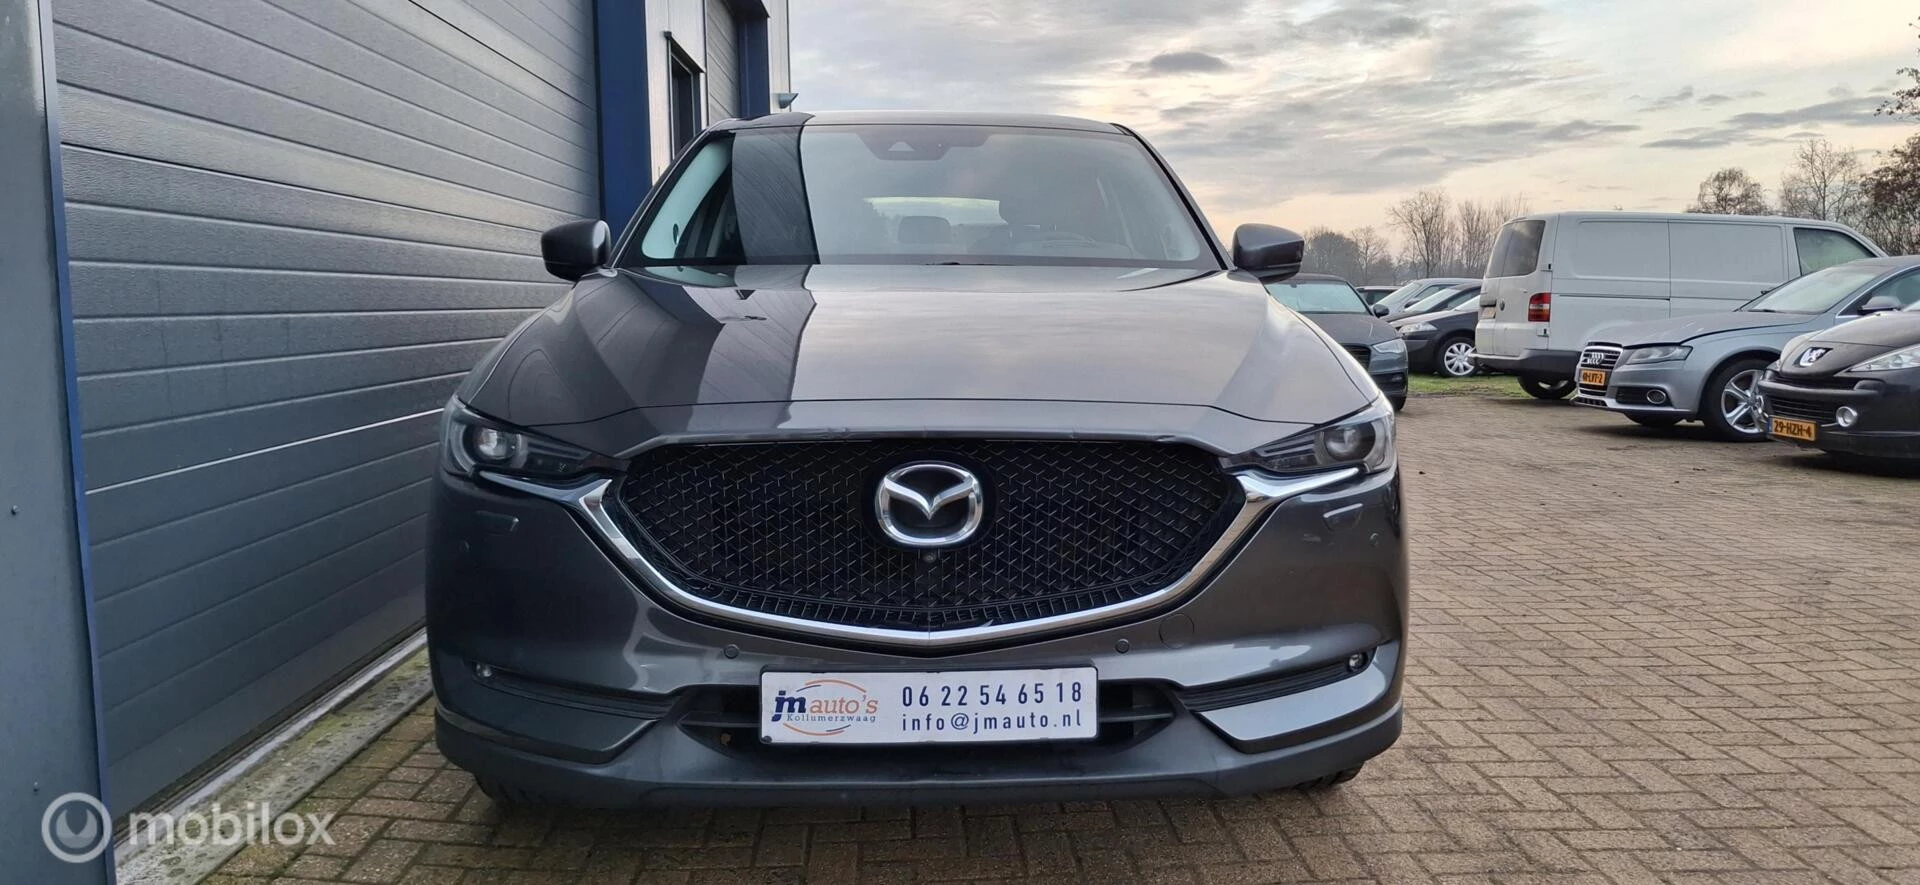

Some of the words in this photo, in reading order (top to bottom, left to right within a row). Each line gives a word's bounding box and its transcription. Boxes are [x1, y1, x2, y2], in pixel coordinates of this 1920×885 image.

[1774, 420, 1813, 438] 29-HZH-4
[809, 694, 879, 714] auto's
[902, 686, 929, 707] 06
[941, 685, 968, 707] 22
[979, 684, 1007, 706] 54
[1018, 683, 1044, 705] 65
[1056, 681, 1082, 703] 18
[787, 714, 877, 723] Kollumerzwaag
[902, 709, 1081, 735] info@jmauto.nl
